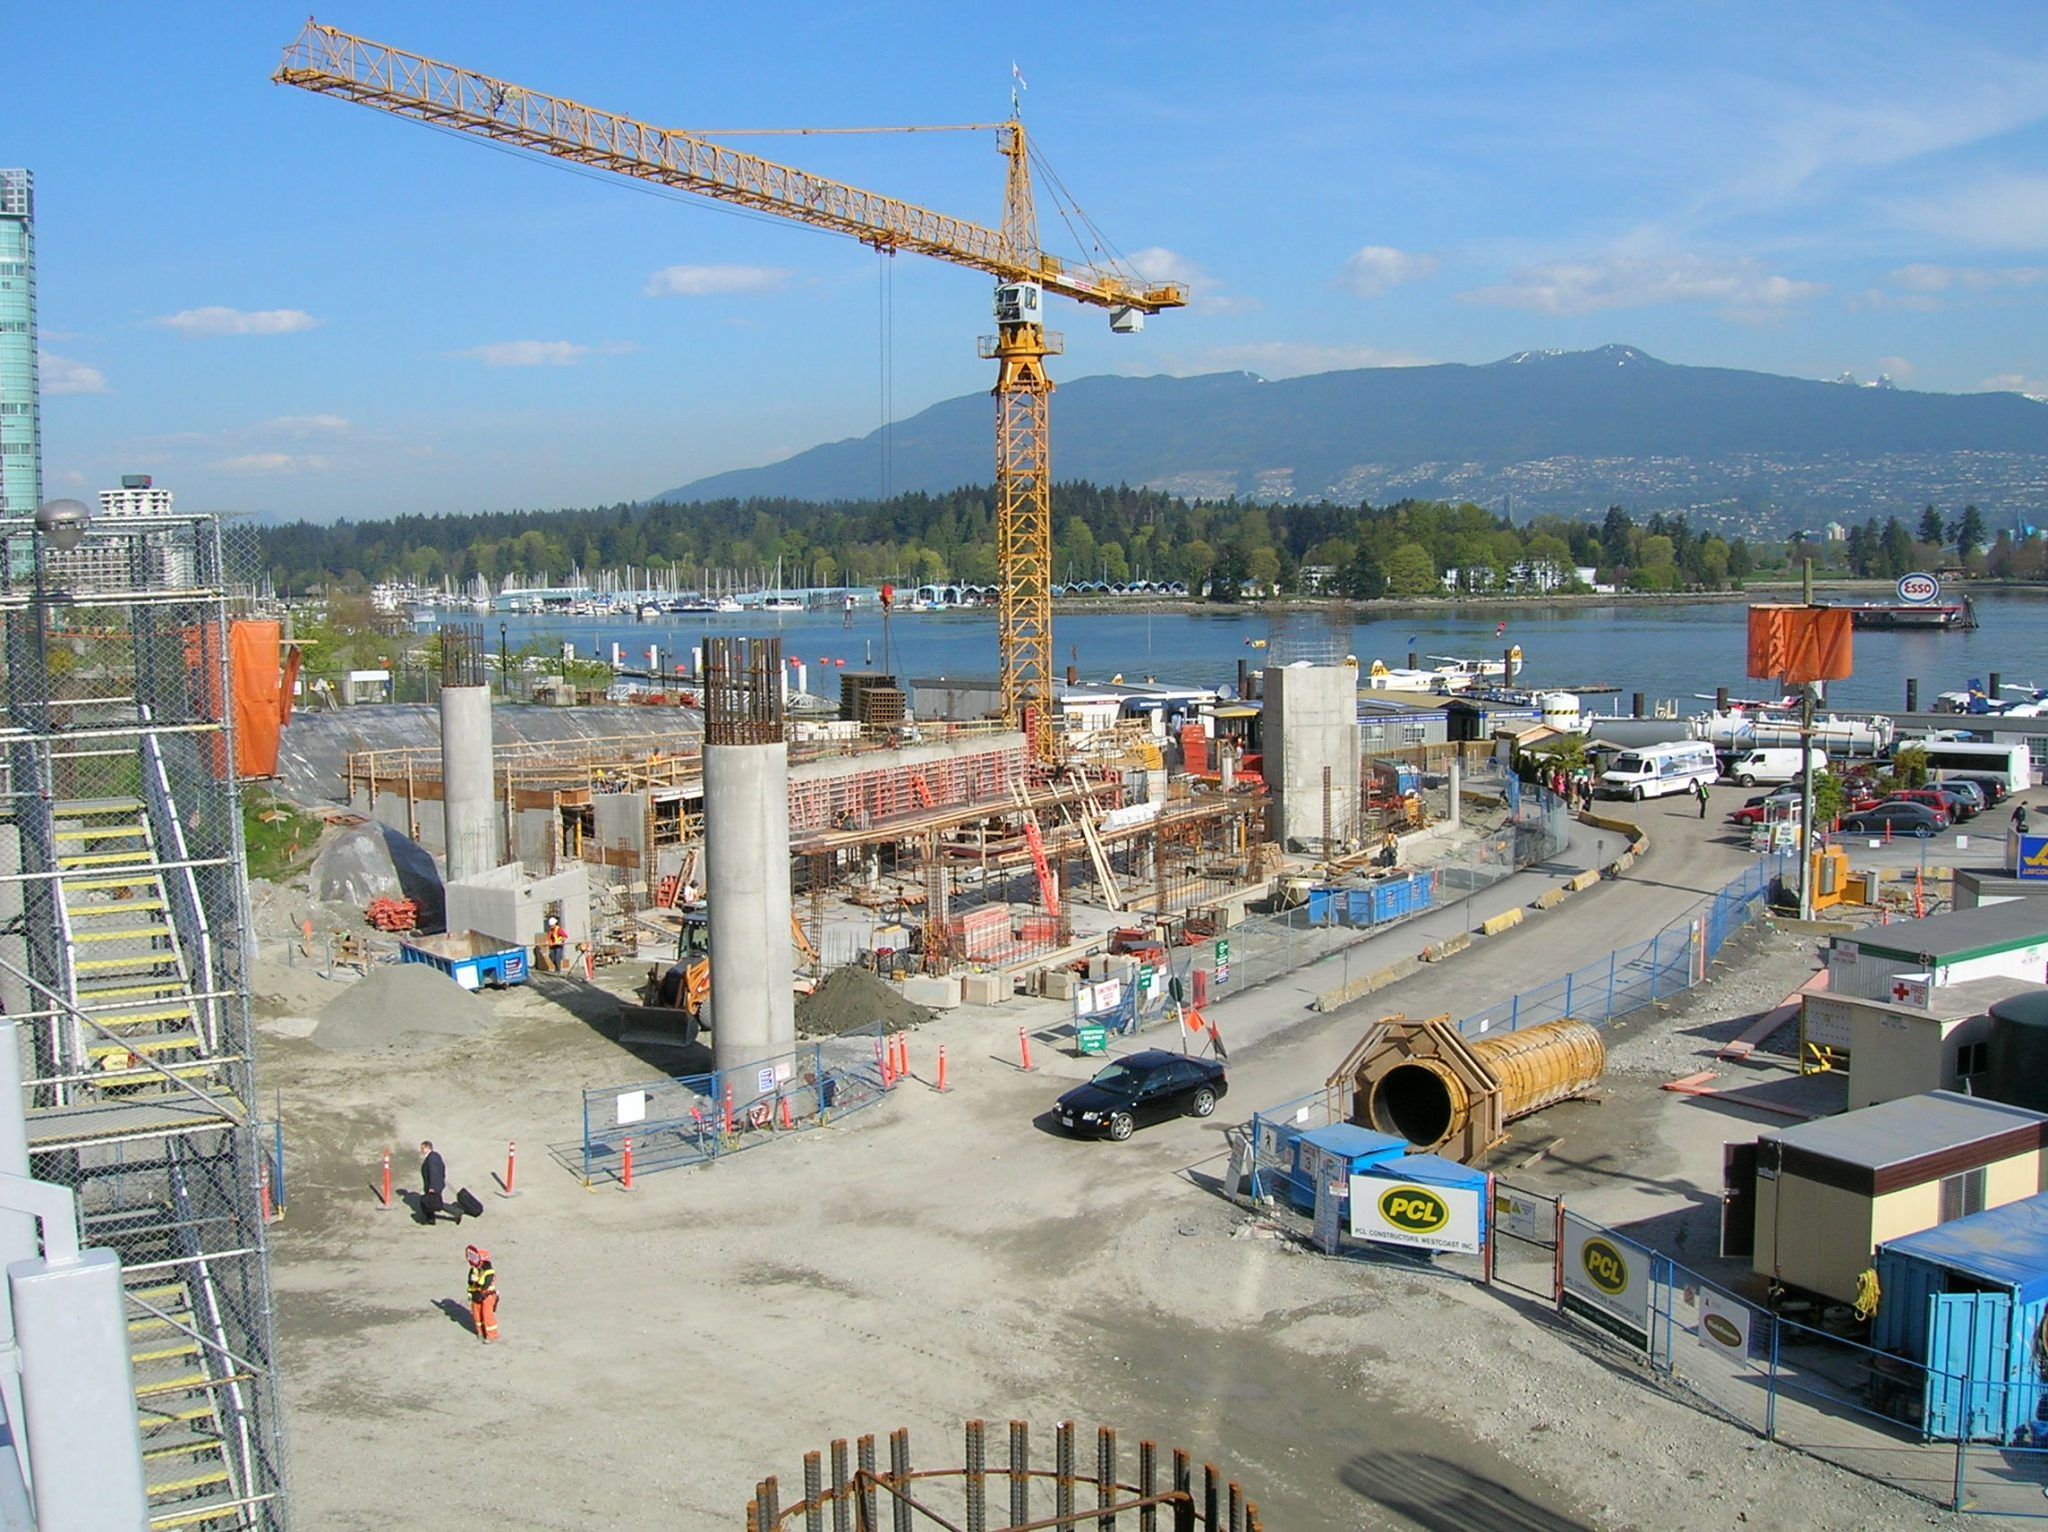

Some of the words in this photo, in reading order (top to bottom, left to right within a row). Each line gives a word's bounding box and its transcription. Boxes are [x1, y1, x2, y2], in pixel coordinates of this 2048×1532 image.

[1389, 1198, 1438, 1222] PCL
[1355, 1227, 1368, 1236] PCL
[1369, 1229, 1419, 1243] CONSTRUCTORS
[1421, 1238, 1459, 1249] WESTCOAST
[1589, 1250, 1620, 1284] PCL
